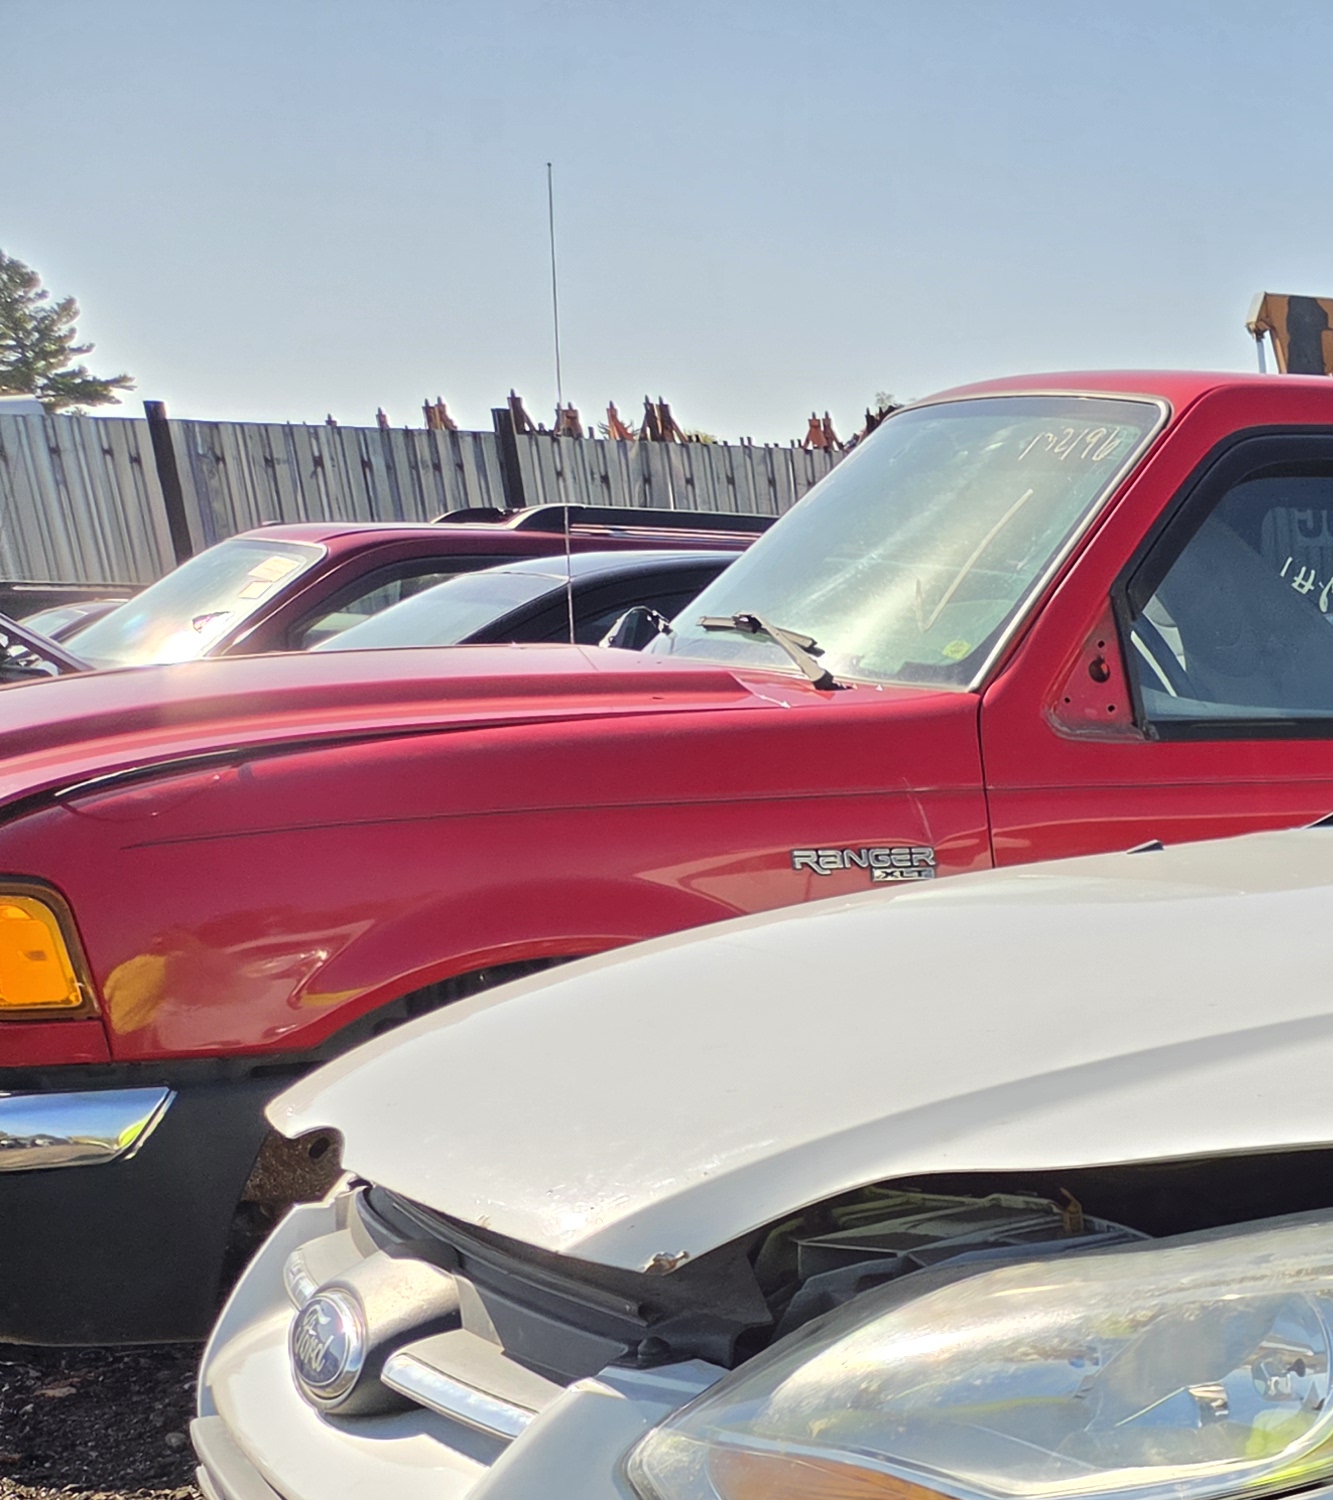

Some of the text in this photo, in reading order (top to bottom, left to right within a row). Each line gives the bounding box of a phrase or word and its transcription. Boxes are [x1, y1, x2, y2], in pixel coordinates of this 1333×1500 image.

[791, 847, 937, 876] RANGER
[876, 870, 925, 880] XLT
[294, 1303, 336, 1373] Ford
